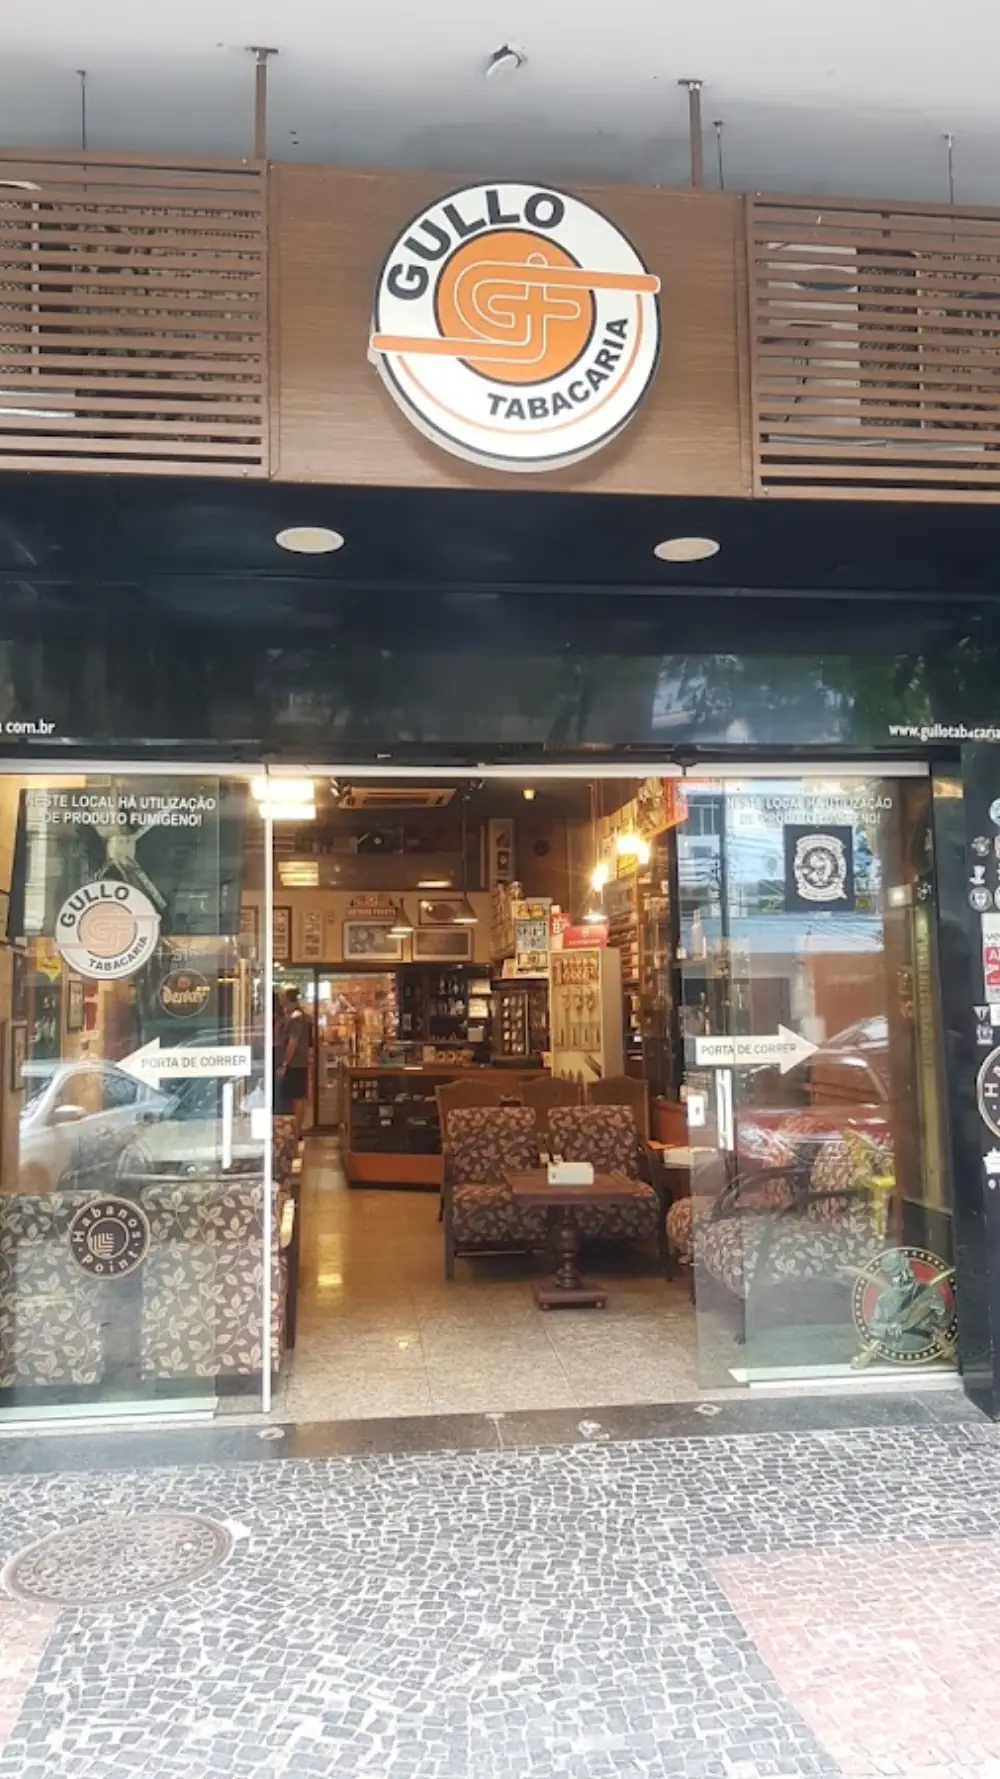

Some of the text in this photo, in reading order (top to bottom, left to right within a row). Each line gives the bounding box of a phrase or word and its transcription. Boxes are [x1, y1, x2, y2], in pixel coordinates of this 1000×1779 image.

[386, 189, 565, 301] GULLO
[487, 317, 629, 420] TABACARIA
[63, 812, 127, 825] PRODUTO
[72, 795, 115, 809] LOCAL
[117, 794, 137, 809] HÁ
[140, 795, 216, 812] UTILIZAÇÃO
[60, 883, 130, 928] GULLO
